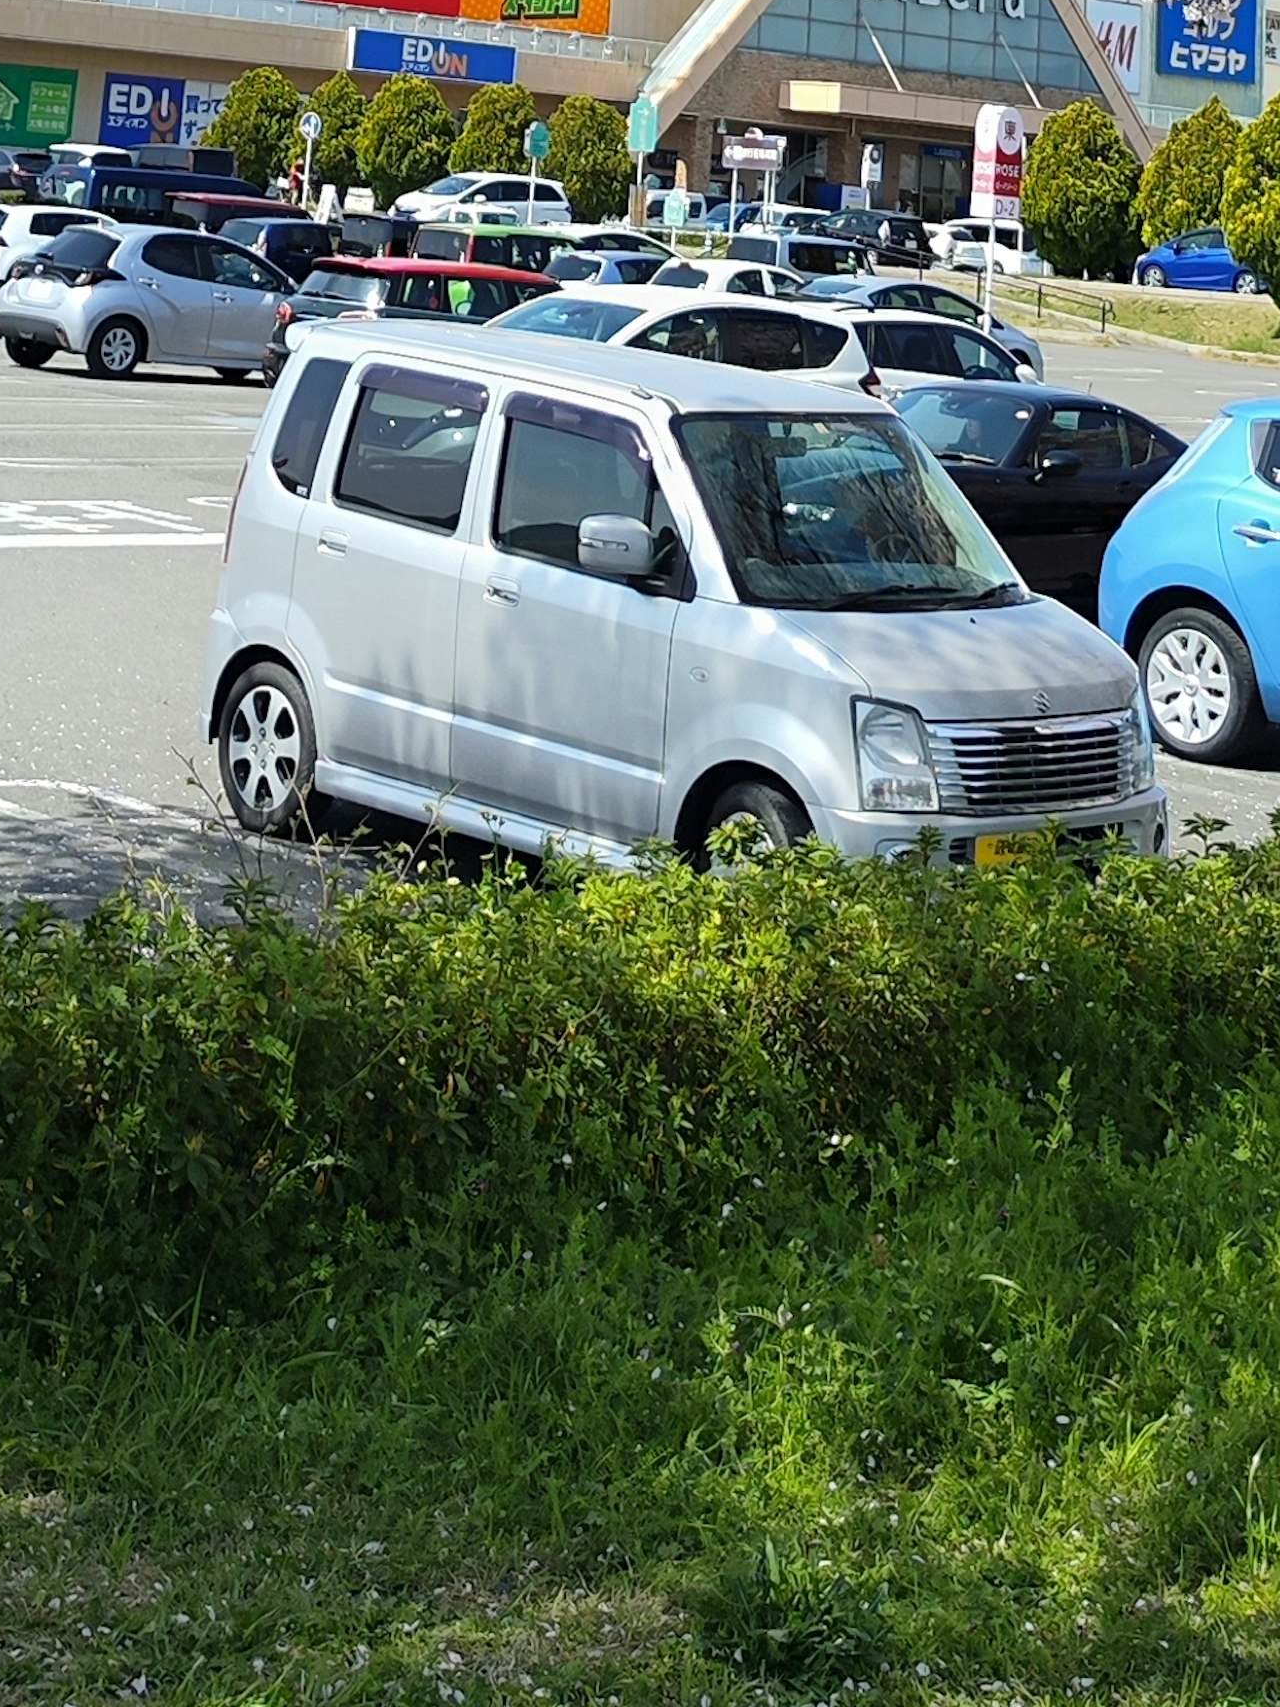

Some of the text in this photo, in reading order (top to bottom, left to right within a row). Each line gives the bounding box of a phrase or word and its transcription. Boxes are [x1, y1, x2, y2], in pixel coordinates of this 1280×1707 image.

[401, 38, 468, 77] EDION
[1170, 40, 1247, 76] ヒマラヤ
[1004, 120, 1017, 141] 東
[995, 163, 1020, 178] ROSE
[995, 198, 1016, 216] D-2
